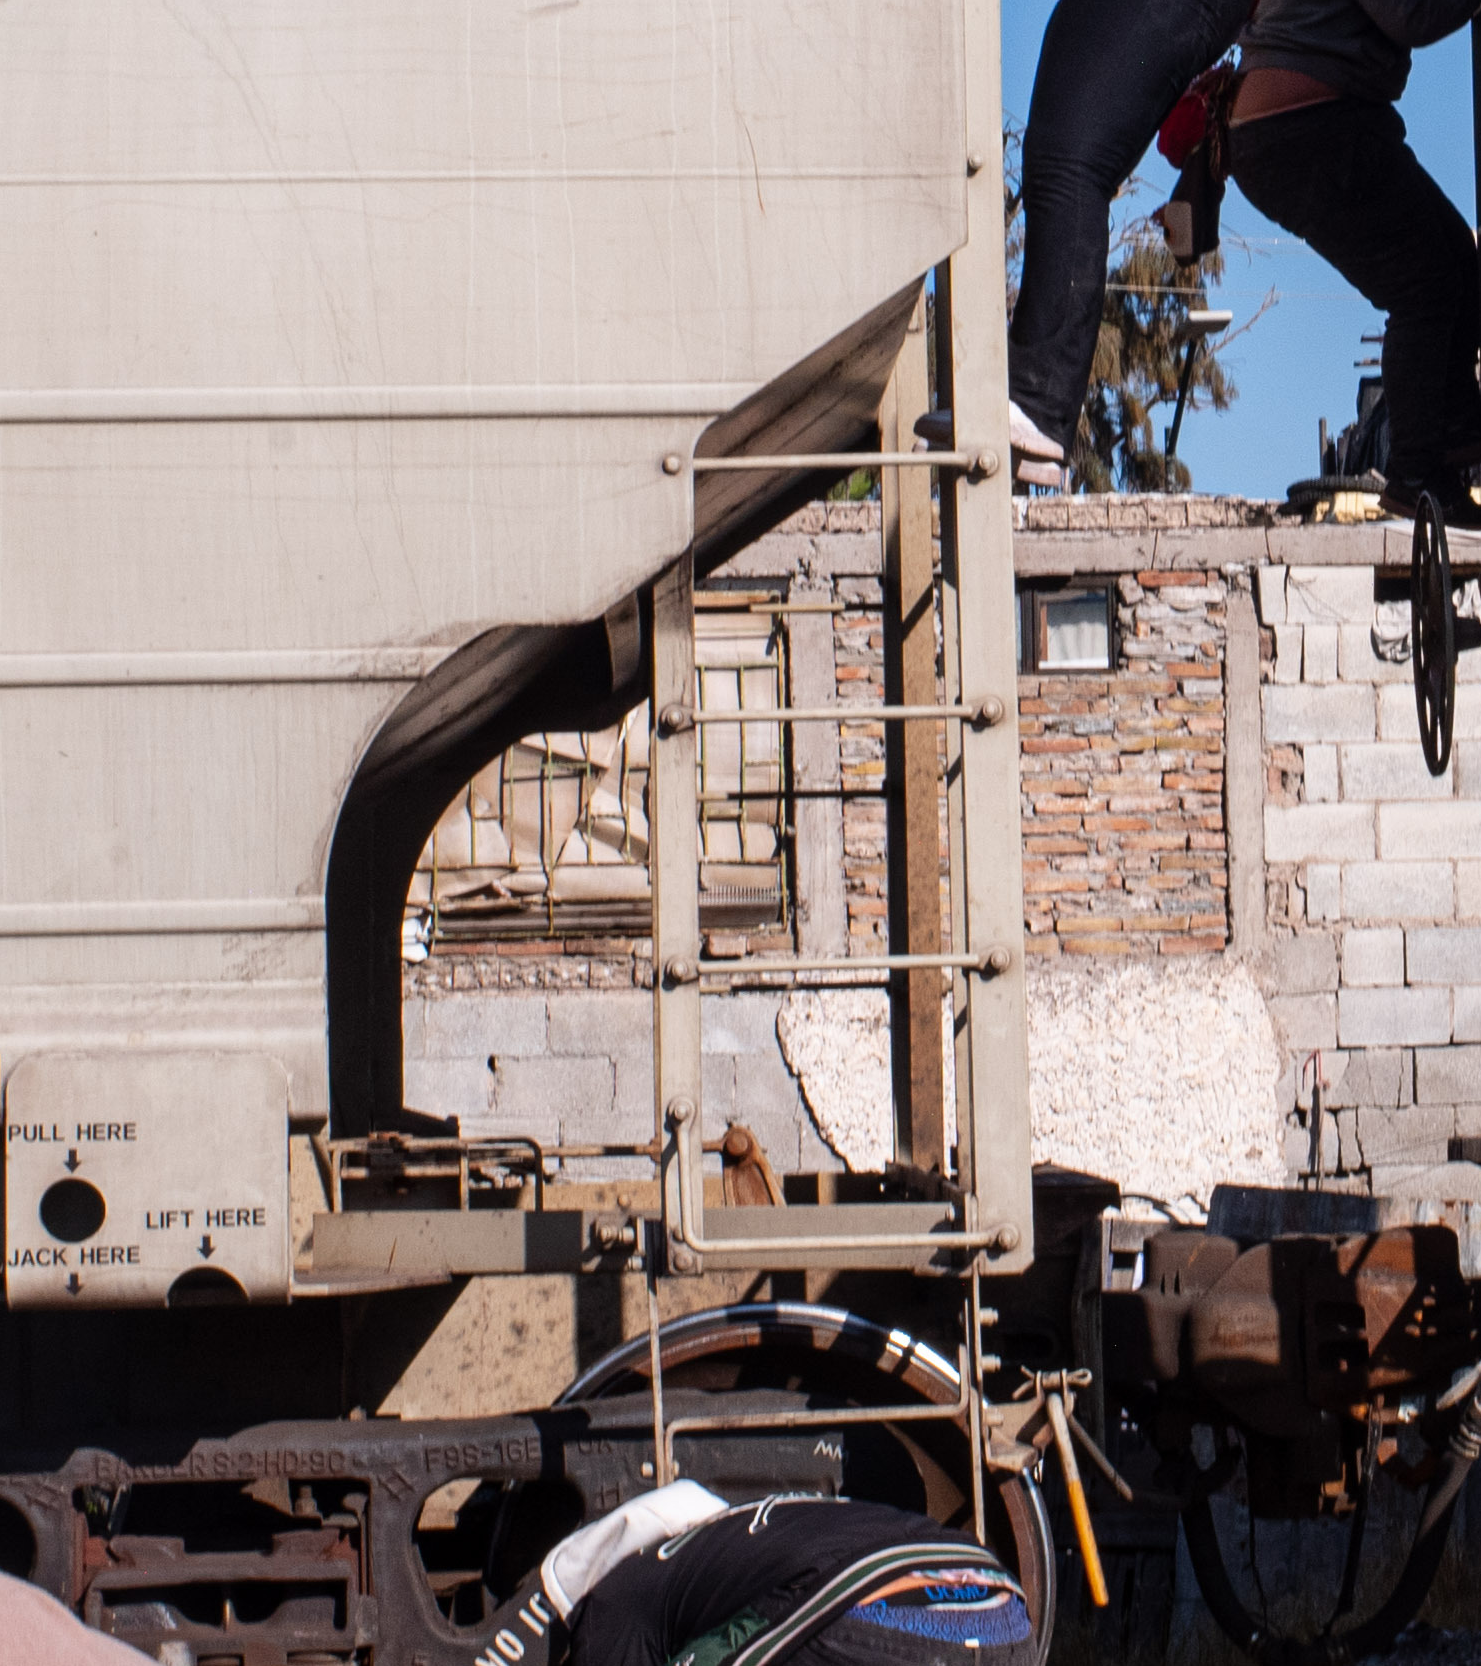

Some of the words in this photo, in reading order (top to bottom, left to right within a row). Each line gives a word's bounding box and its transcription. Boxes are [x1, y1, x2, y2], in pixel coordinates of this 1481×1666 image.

[8, 1123, 65, 1142] PULL
[76, 1122, 137, 1141] HERE
[146, 1210, 194, 1229] LIFT
[206, 1207, 266, 1227] HERE
[7, 1248, 68, 1267] JACK
[80, 1245, 141, 1265] HERE
